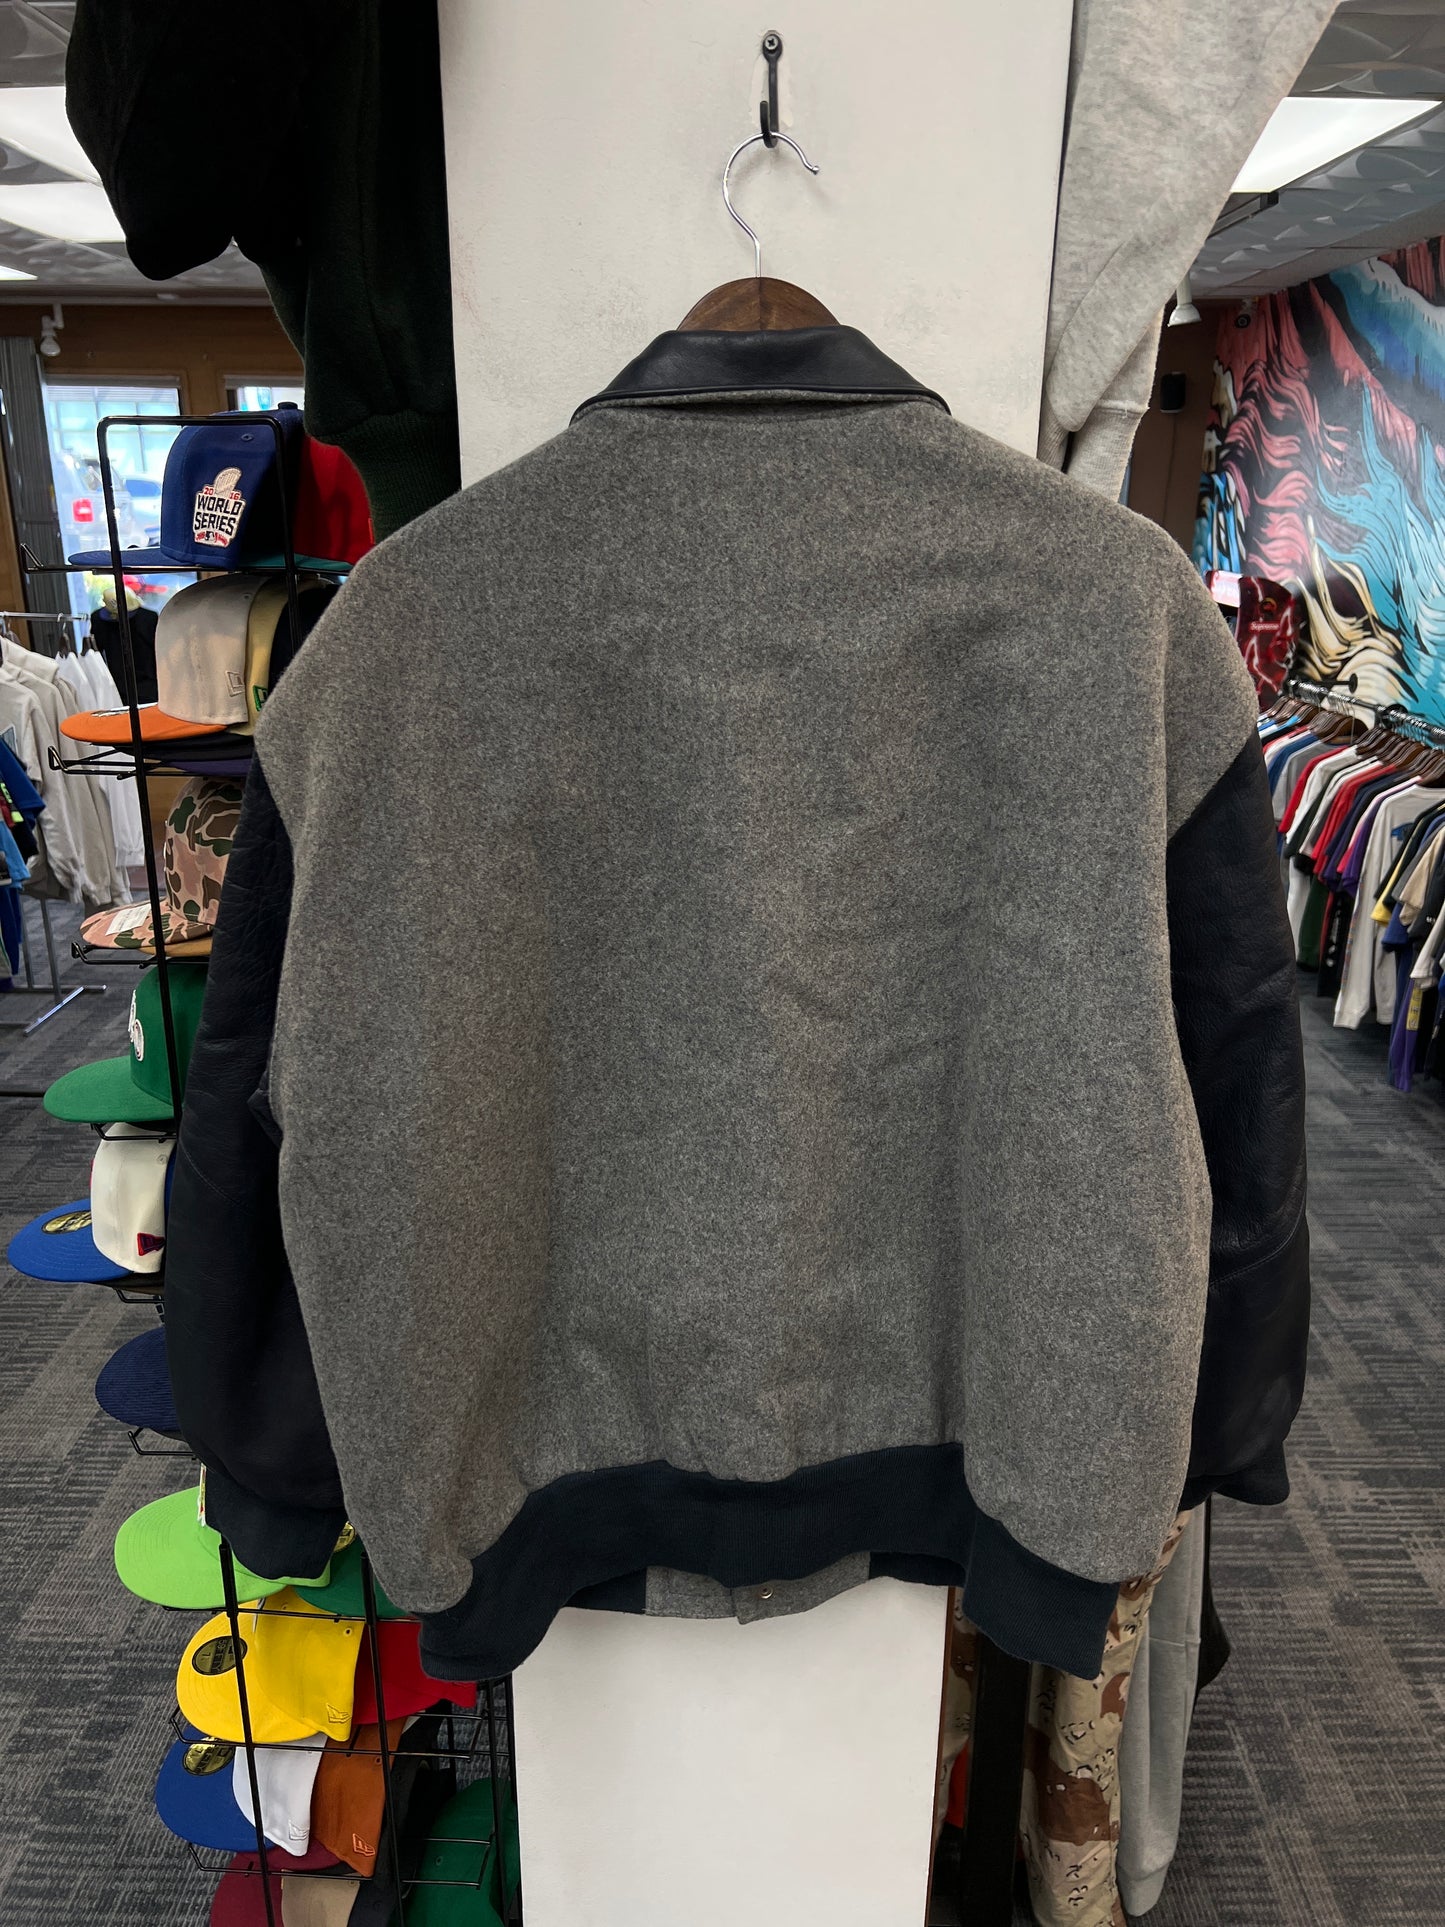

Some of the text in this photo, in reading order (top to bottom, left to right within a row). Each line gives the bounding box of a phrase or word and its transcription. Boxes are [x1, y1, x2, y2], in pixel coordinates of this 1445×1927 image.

[197, 494, 243, 515] WORLD
[203, 487, 241, 501] 20 16
[194, 511, 237, 536] SERIES
